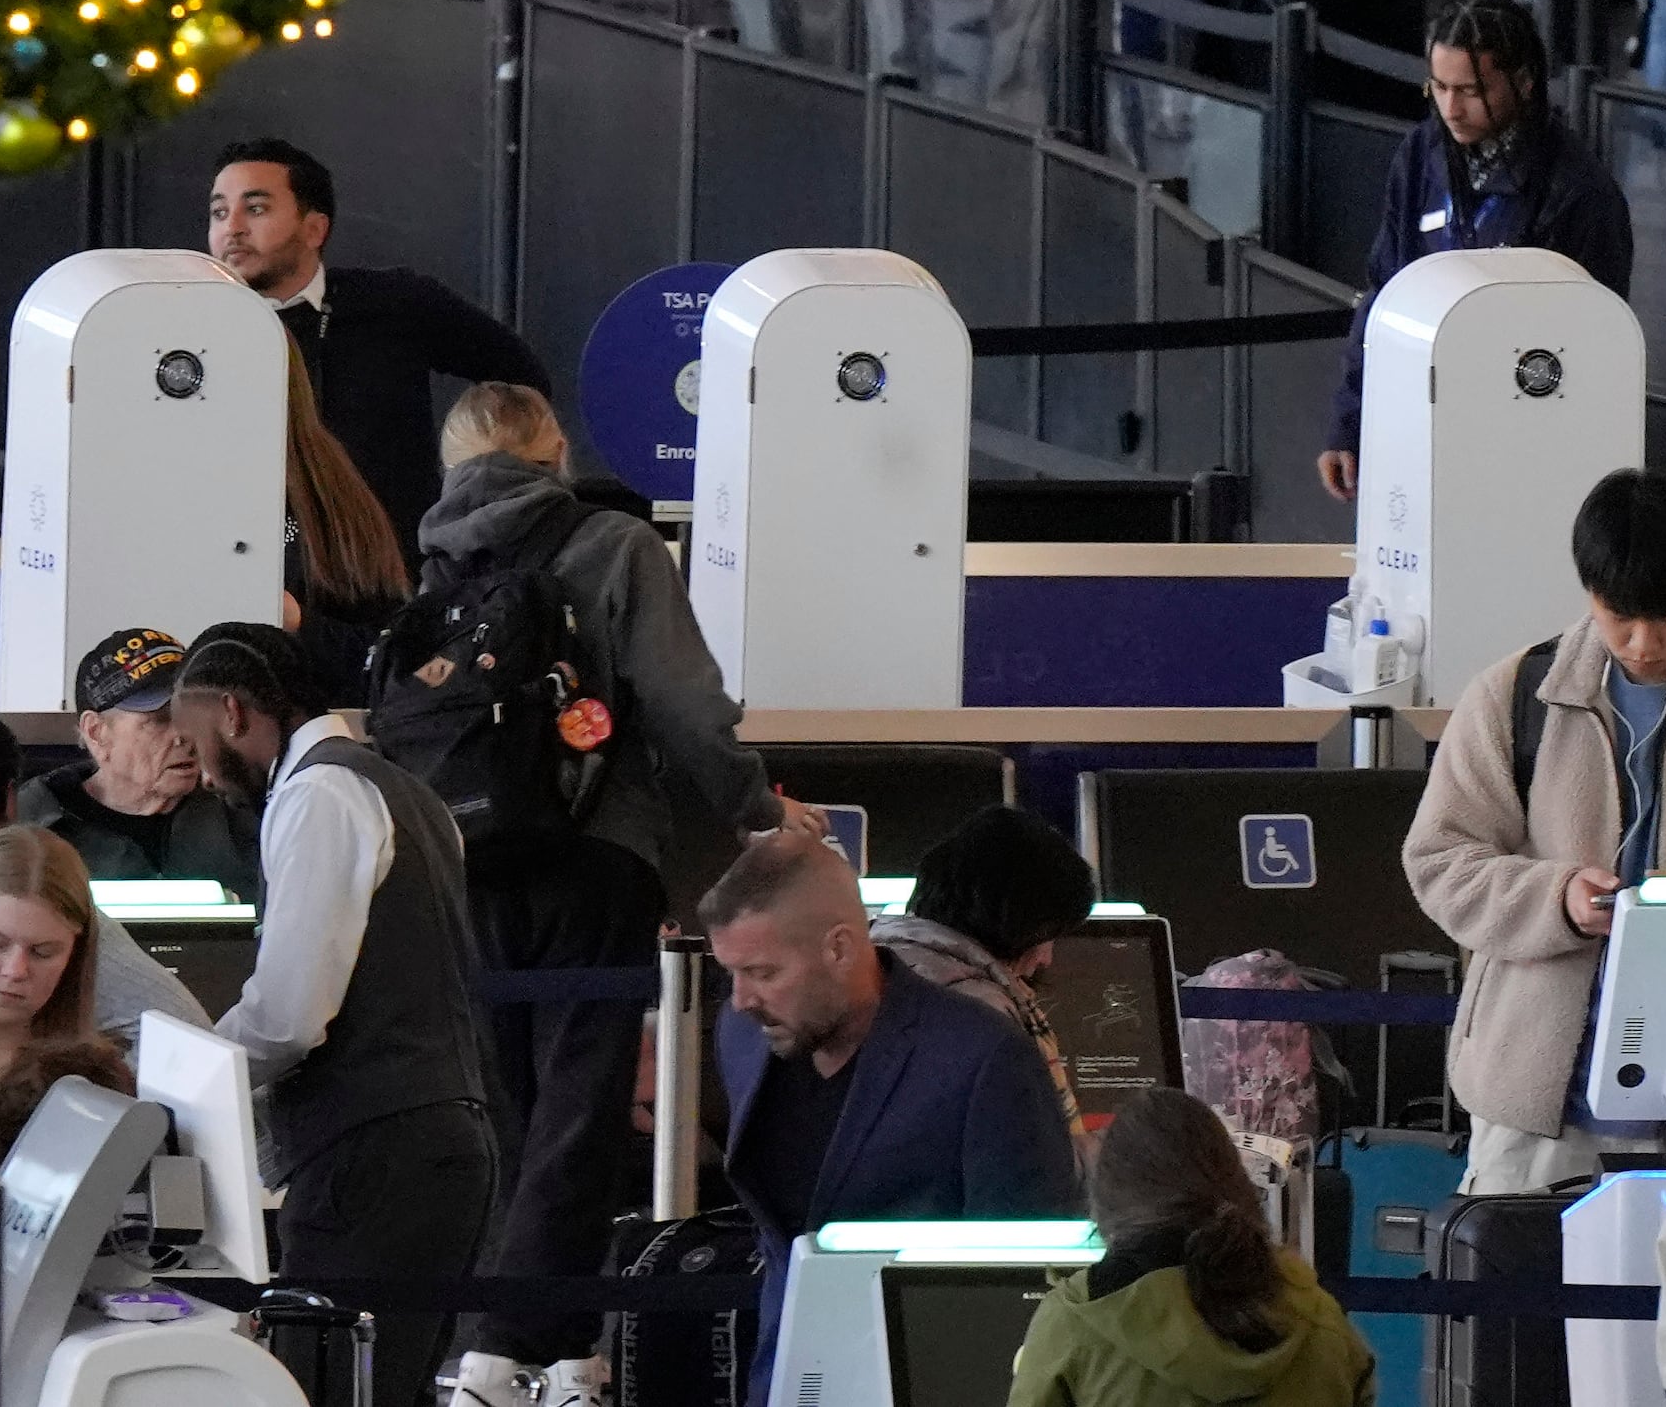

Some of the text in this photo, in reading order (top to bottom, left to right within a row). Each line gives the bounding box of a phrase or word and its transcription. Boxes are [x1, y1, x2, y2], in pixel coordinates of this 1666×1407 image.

[663, 292, 694, 309] TSA
[656, 443, 696, 460] Enro
[20, 546, 55, 574] CLEAR
[706, 542, 736, 571] CLEAR
[1377, 546, 1419, 574] CLEAR
[712, 1311, 732, 1378] KIPLI
